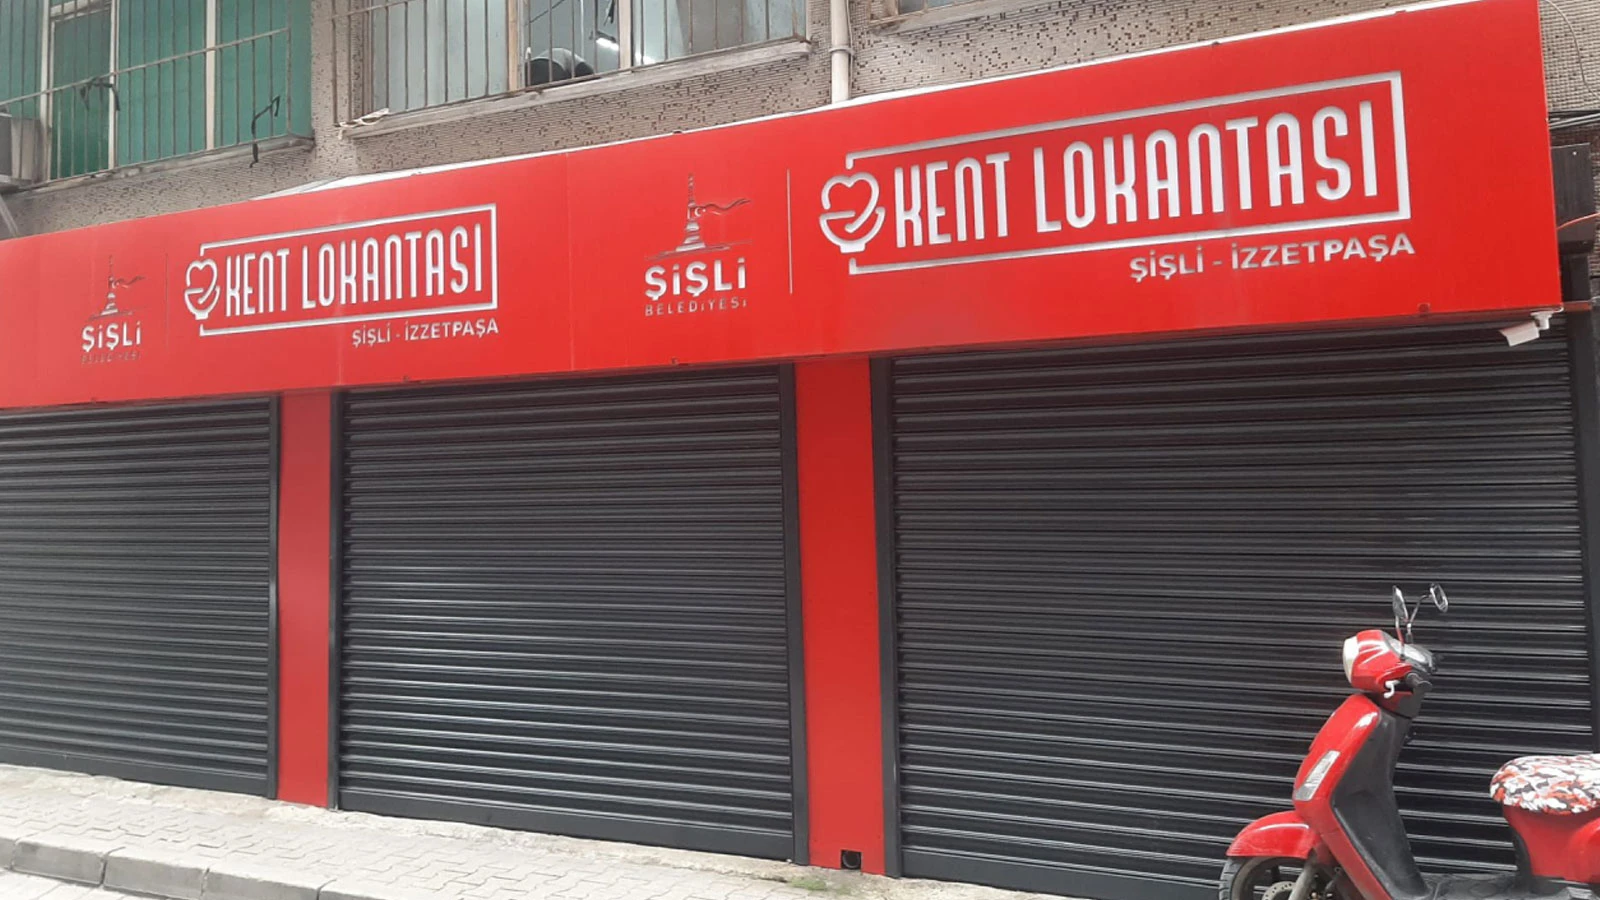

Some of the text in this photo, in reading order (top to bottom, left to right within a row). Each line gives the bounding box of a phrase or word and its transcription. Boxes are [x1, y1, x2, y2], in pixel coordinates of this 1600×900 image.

[894, 101, 1379, 248] KENT LOKANTASI
[225, 224, 483, 318] KENT LOKANTASI
[644, 257, 747, 301] ŞİŞLİ
[1130, 246, 1204, 283] ŞİŞLİ
[1230, 233, 1416, 271] İZZETPAŞA
[81, 321, 142, 353] ŞİŞLİ
[351, 322, 392, 348] ŞİŞLİ
[404, 318, 499, 342] İZZETPAŞA
